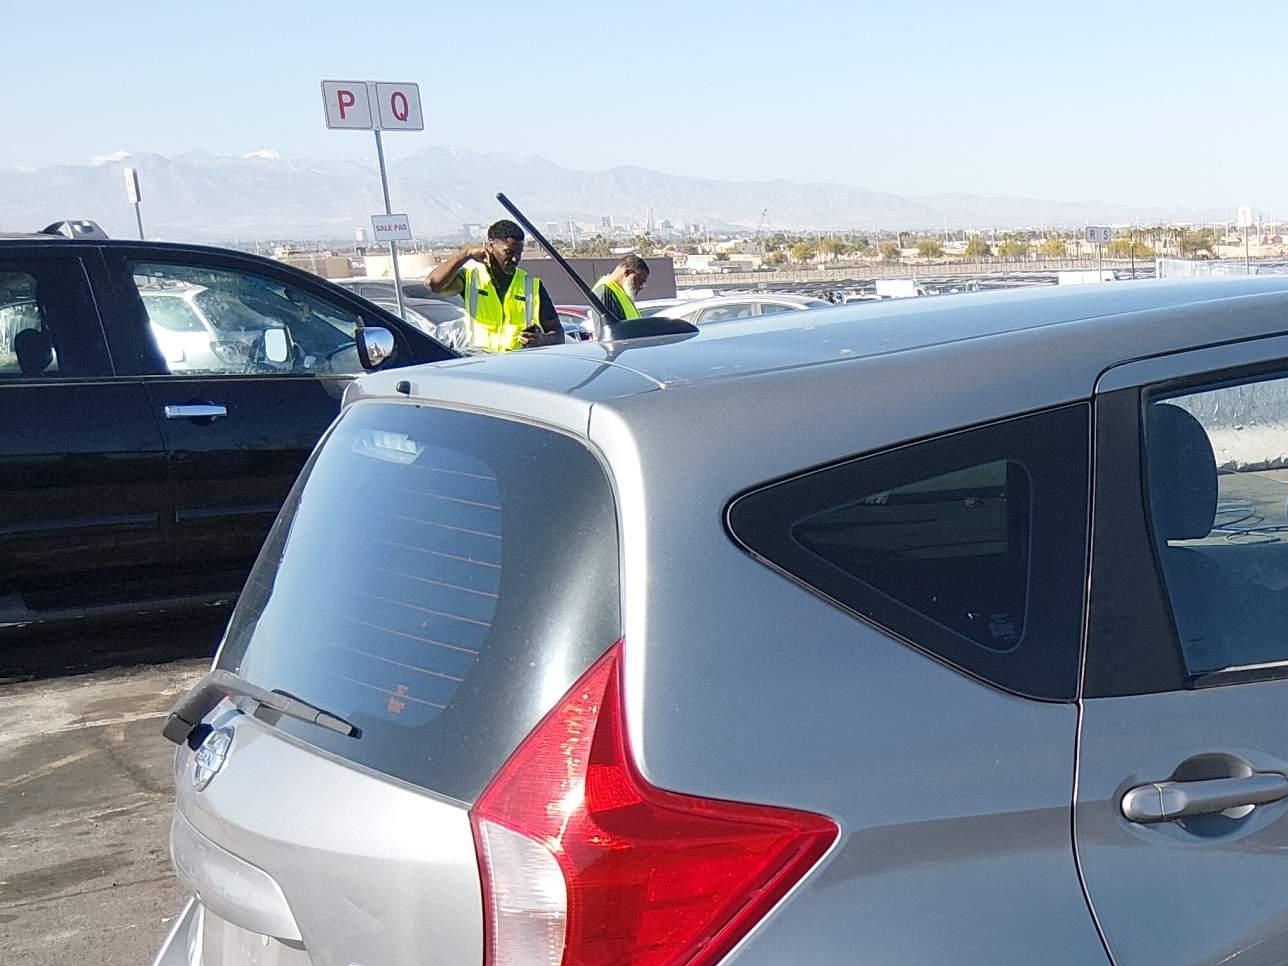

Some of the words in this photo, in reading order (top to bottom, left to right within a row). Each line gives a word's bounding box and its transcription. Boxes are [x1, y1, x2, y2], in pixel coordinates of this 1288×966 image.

[337, 90, 355, 120] P
[391, 91, 409, 122] Q
[375, 224, 392, 232] SALE
[393, 223, 408, 231] PAD
[1090, 229, 1096, 241] R
[1103, 230, 1109, 241] S
